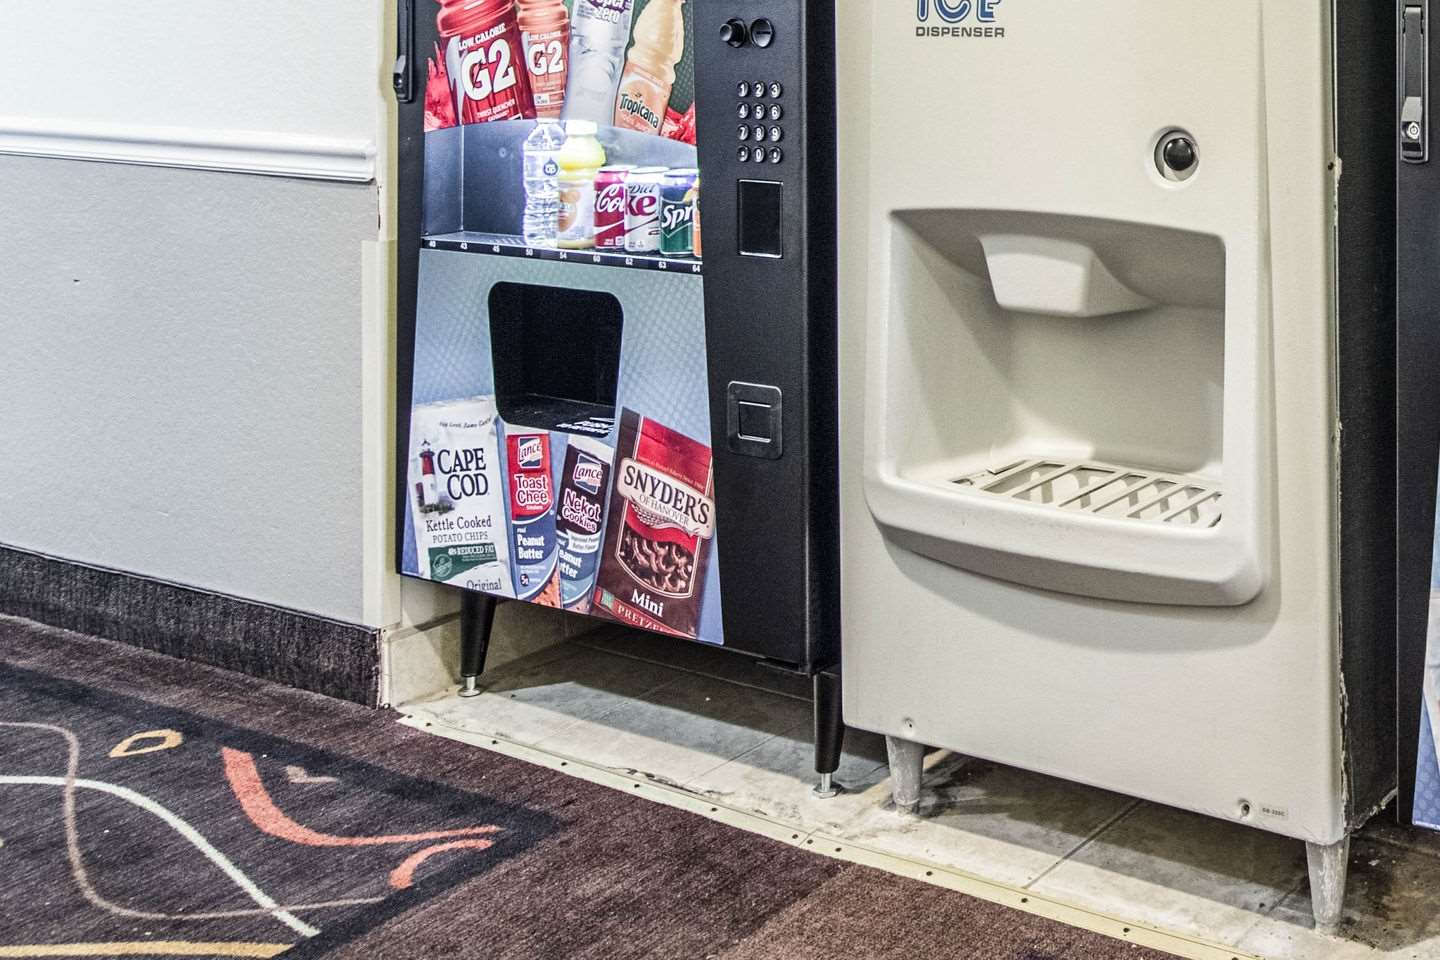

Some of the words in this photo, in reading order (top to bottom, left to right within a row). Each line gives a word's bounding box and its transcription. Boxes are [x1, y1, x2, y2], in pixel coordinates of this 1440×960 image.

[598, 6, 620, 24] zero
[475, 23, 507, 45] CALORIE
[916, 27, 1005, 37] DISPENSER
[528, 40, 564, 76] G2
[462, 38, 517, 101] G2
[619, 93, 659, 129] Tropicana
[437, 448, 486, 474] CAPE
[519, 442, 541, 461] Lance
[515, 475, 547, 490] Toast
[574, 465, 602, 480] Lance
[447, 473, 488, 500] COD
[624, 465, 709, 525] SNYDER'S
[517, 491, 547, 505] Chee
[564, 489, 600, 521] Nekot
[639, 494, 650, 504] OF
[651, 498, 689, 526] HANOVER
[426, 519, 454, 532] Kettle
[457, 515, 492, 529] Cooked
[562, 510, 597, 533] Cookies
[433, 533, 462, 543] POTATO
[465, 531, 488, 541] CHIPS
[517, 534, 544, 546] Peanut
[518, 547, 543, 559] Butter
[631, 589, 664, 618] Mini
